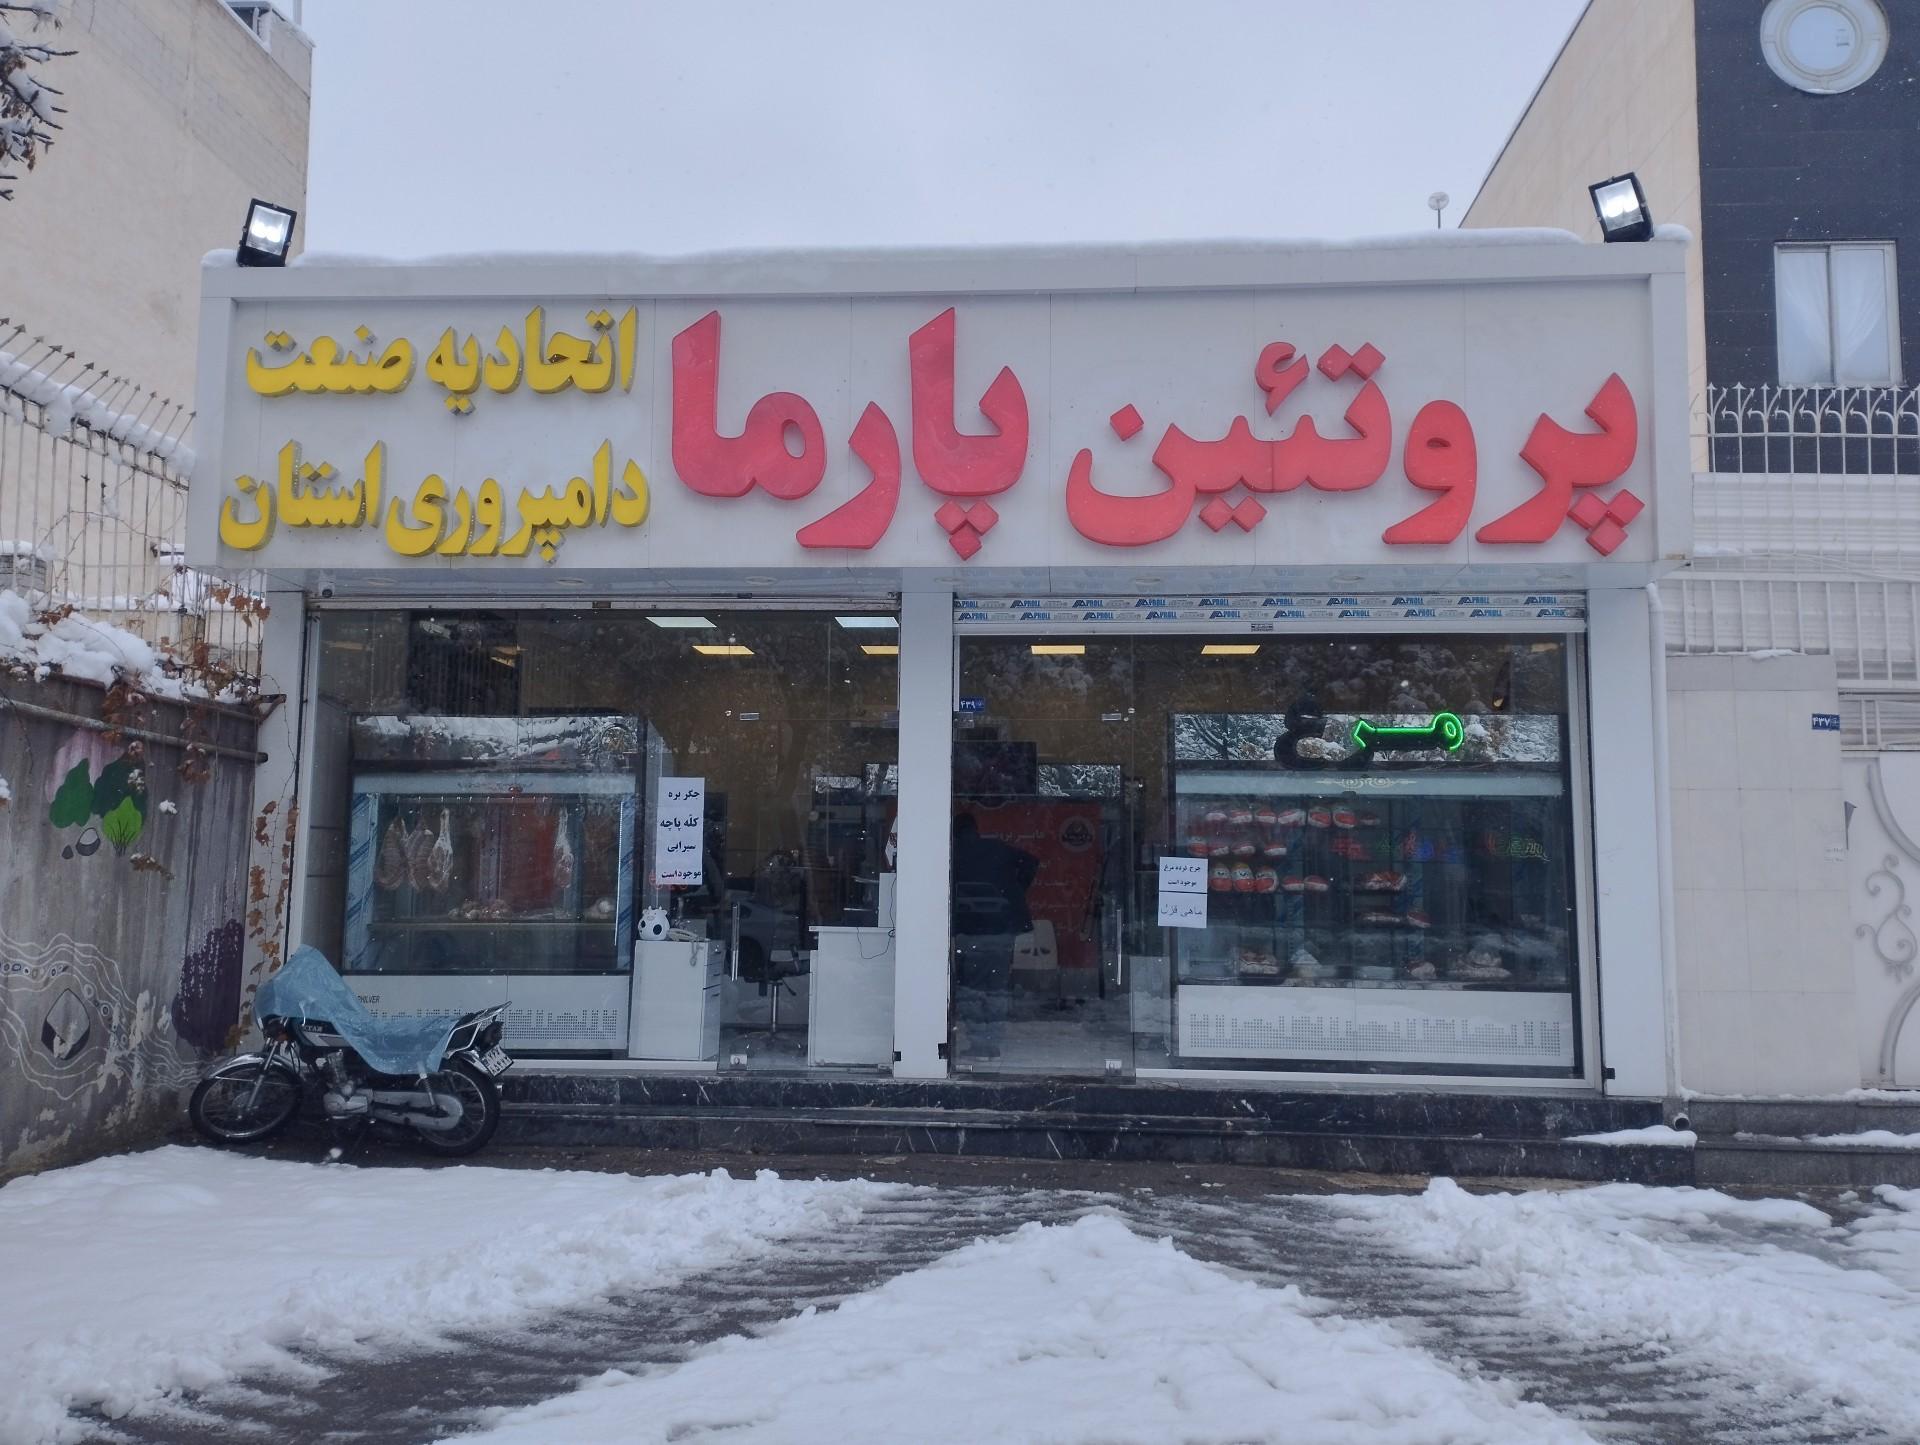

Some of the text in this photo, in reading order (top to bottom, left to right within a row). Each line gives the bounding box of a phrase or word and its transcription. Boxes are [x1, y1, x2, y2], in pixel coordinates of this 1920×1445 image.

[246, 305, 638, 416] اتحادیه صنعت
[672, 307, 1645, 561] پروتئین پارما
[219, 437, 650, 564] دامپروری استان
[660, 817, 681, 831] پاچه
